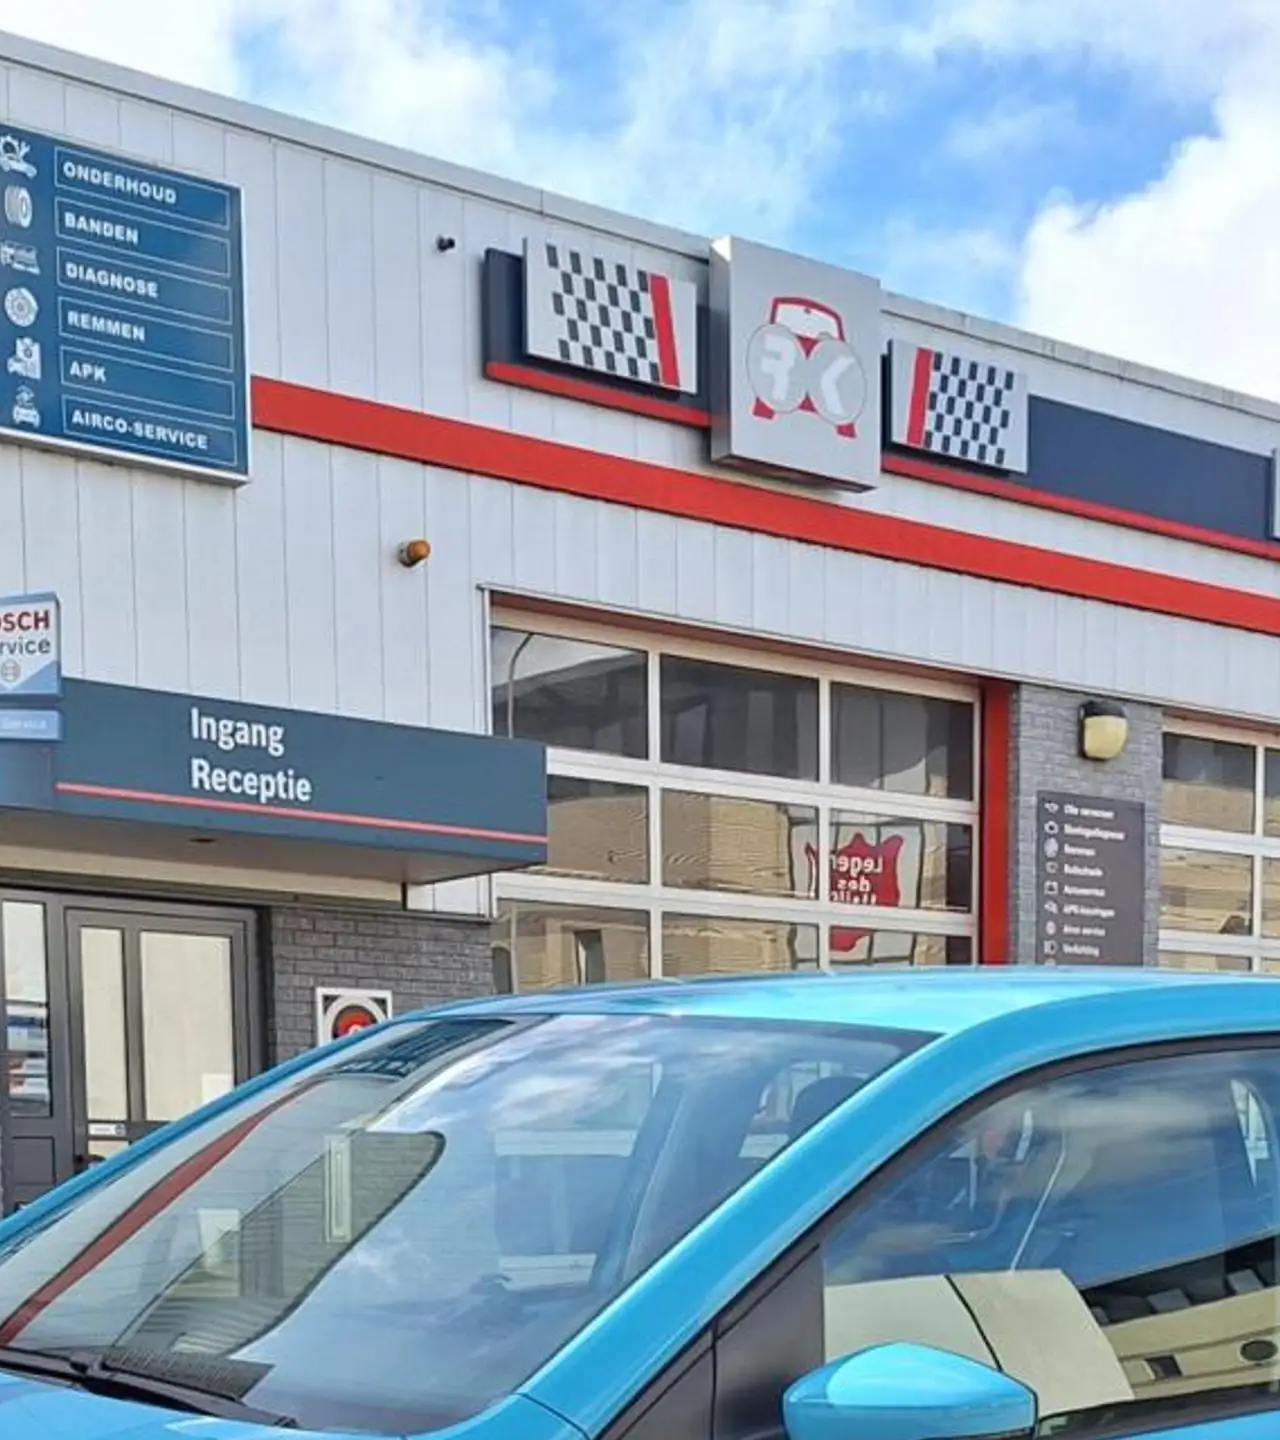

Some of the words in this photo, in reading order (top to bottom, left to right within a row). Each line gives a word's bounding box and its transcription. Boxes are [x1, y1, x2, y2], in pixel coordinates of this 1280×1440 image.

[63, 161, 177, 204] ONDERHOUD
[64, 211, 139, 245] BANDEN
[65, 261, 159, 298] DIAGNOSE
[67, 310, 146, 342] REMMEN
[69, 359, 107, 383] APK
[71, 408, 209, 450] AIRCO-SERVICE
[190, 706, 285, 757] Ingang
[190, 757, 313, 804] Receptie
